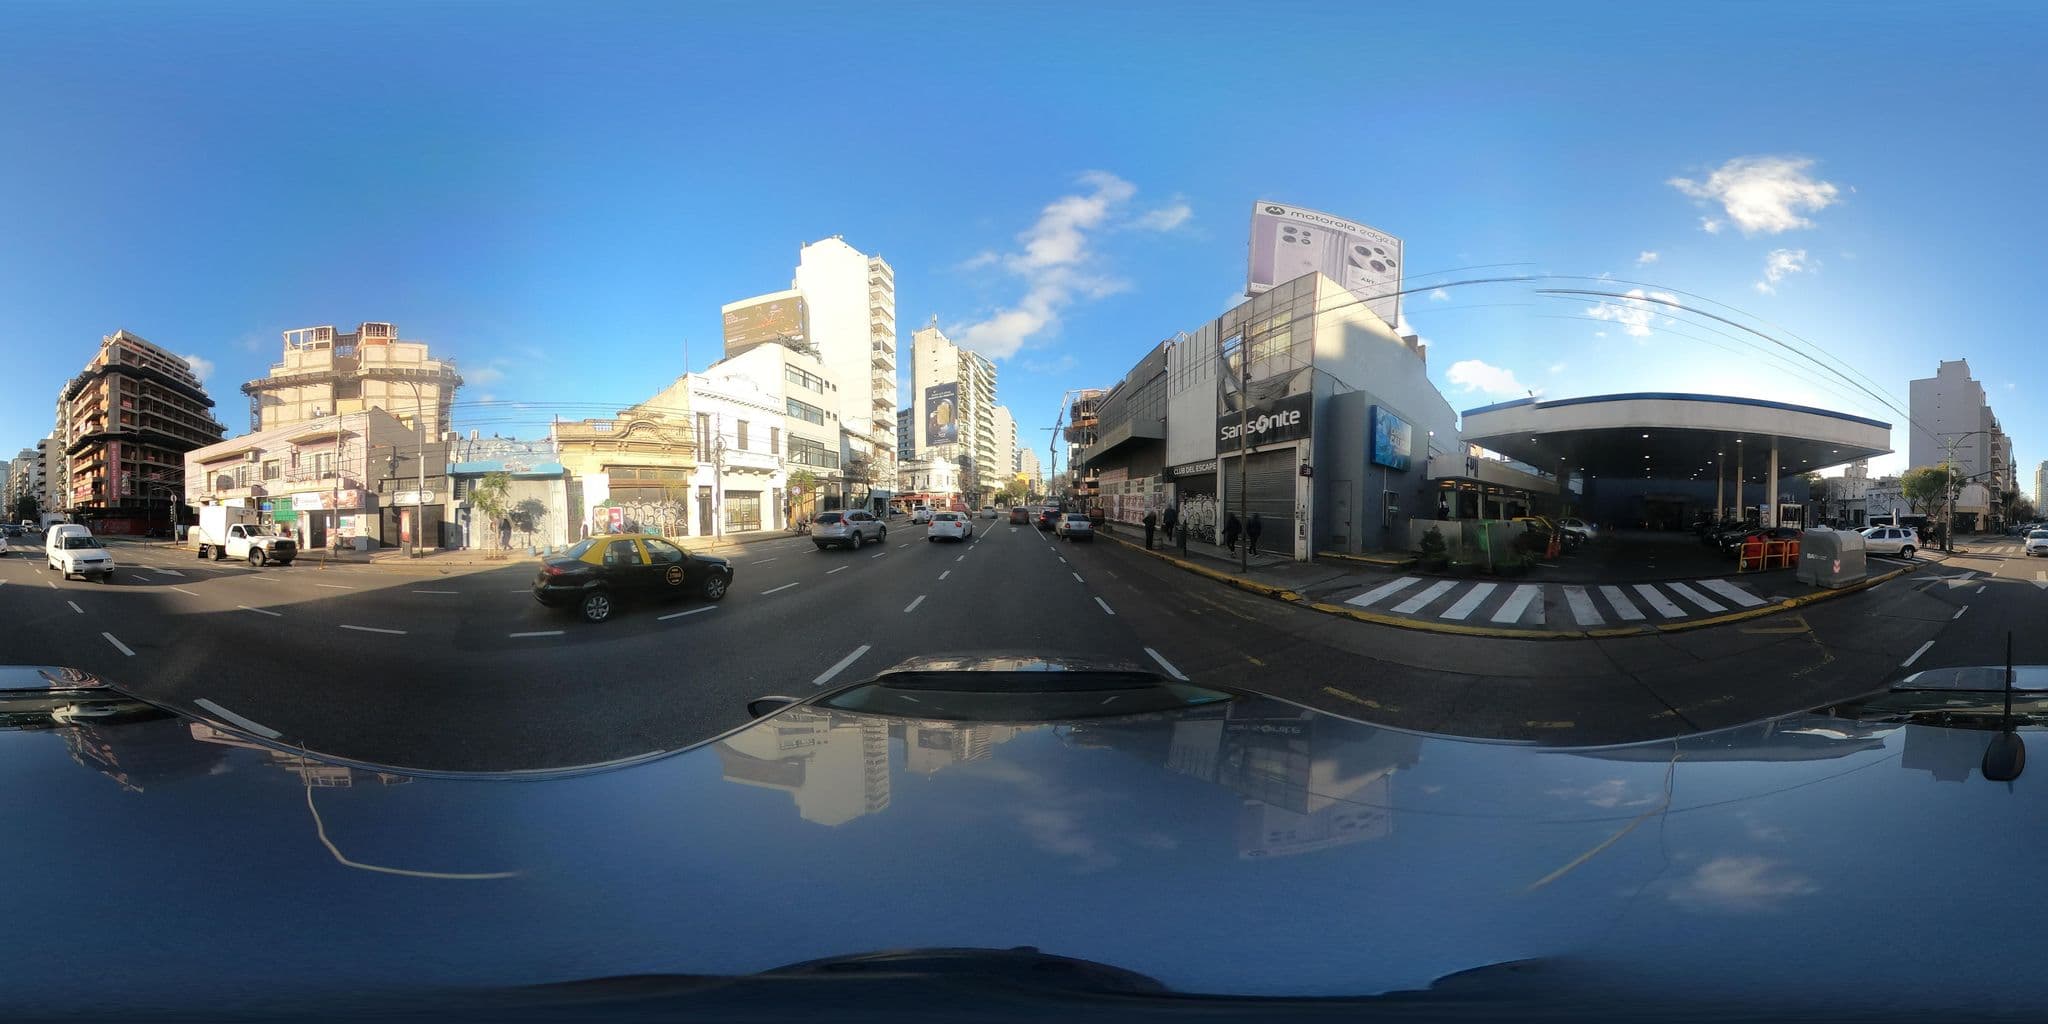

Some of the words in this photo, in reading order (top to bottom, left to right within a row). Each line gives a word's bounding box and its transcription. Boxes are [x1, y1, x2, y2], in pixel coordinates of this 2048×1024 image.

[1291, 211, 1356, 232] motorola
[1360, 229, 1389, 243] edge
[1221, 410, 1300, 440] Samsonite
[1173, 466, 1186, 476] CLUB
[1186, 464, 1195, 474] DEL
[1196, 462, 1217, 473] ESCAPE
